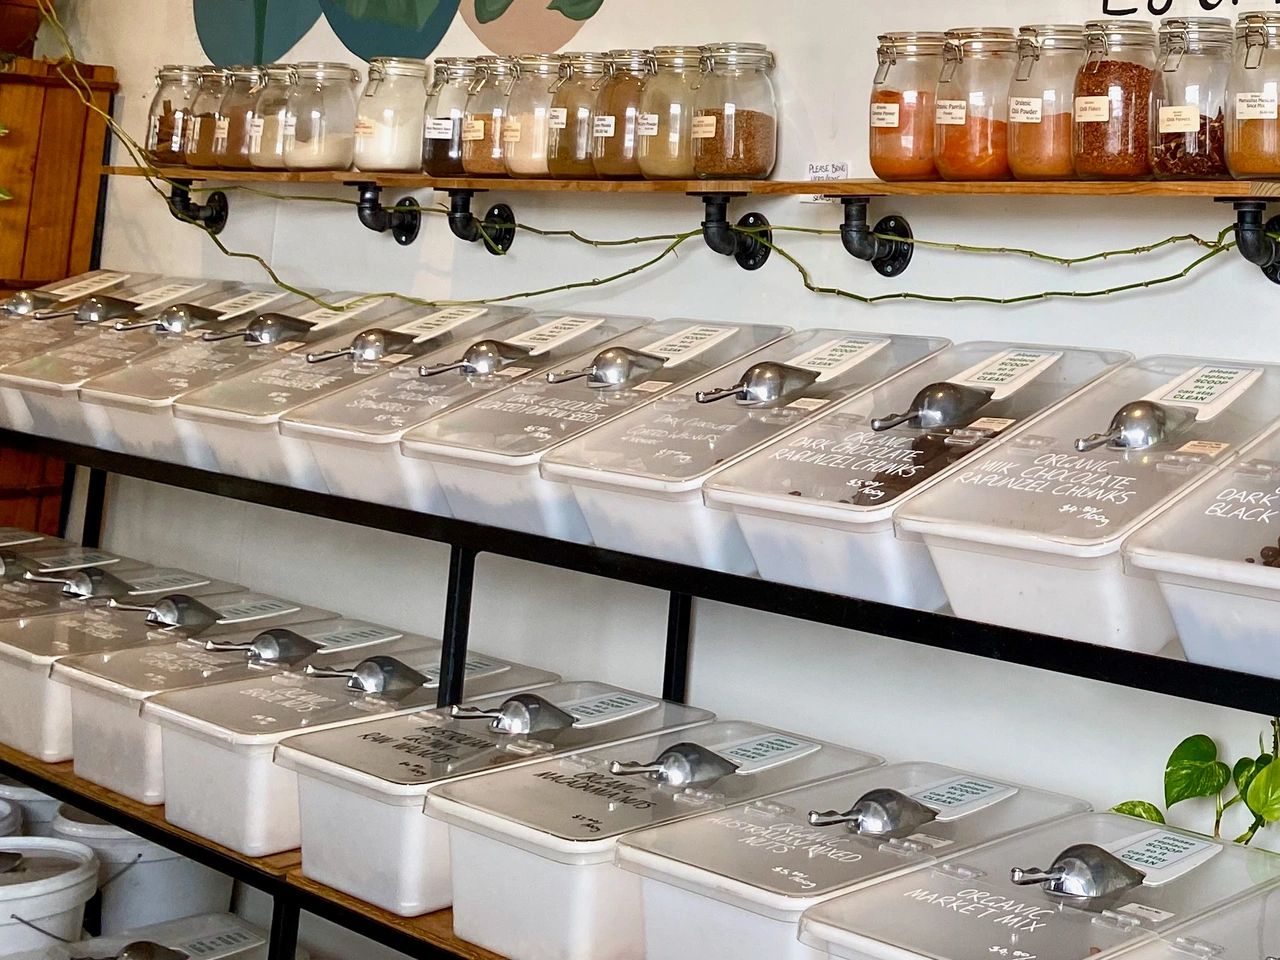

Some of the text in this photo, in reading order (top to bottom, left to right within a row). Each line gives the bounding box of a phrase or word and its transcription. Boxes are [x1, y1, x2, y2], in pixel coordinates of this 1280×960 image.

[788, 436, 924, 462] DARK CHOCOLATE
[769, 448, 924, 477] RAPUNZEL CHUNKS
[1034, 453, 1119, 472] ORGANIC
[1020, 466, 1136, 489] CHOCOLATE
[954, 471, 1136, 504] RAPUNZEL CHUNKS
[1216, 488, 1279, 507] DARK
[1205, 502, 1279, 524] BLACK
[738, 836, 795, 853] NUTS
[1146, 843, 1183, 854] SCOOP
[1154, 839, 1189, 850] replace
[1163, 836, 1195, 846] please
[802, 845, 862, 862] MIXED
[1122, 854, 1158, 866] CLEAN
[1127, 849, 1145, 857] can
[904, 889, 1046, 932] MARKET MIX
[957, 889, 1054, 920] ORGANIC
